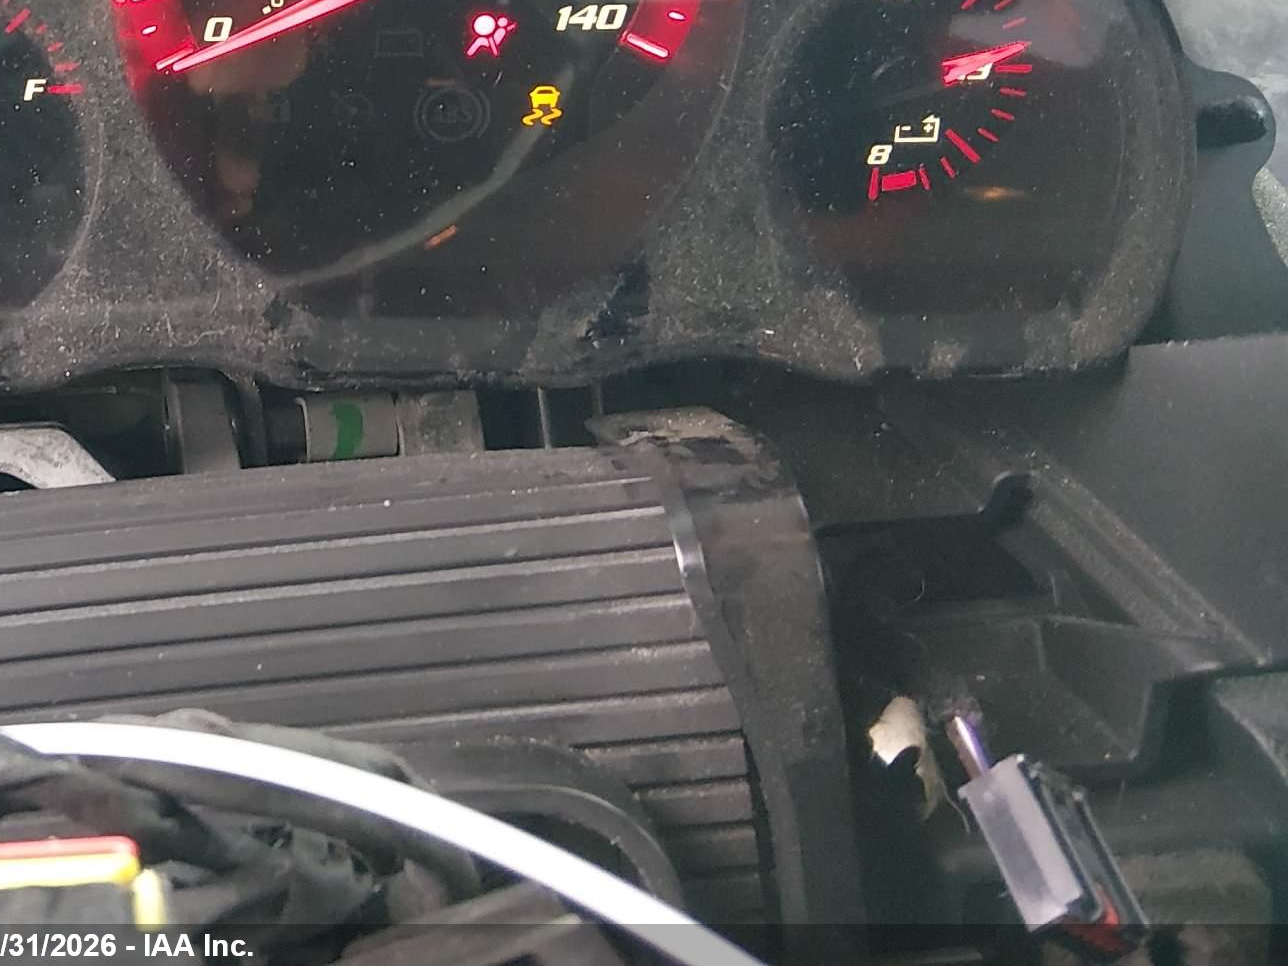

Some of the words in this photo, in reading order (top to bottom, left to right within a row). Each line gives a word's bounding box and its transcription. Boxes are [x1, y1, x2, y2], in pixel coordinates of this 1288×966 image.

[202, 16, 234, 44] 0
[556, 3, 628, 32] 140
[23, 77, 48, 102] F
[867, 144, 893, 165] 8
